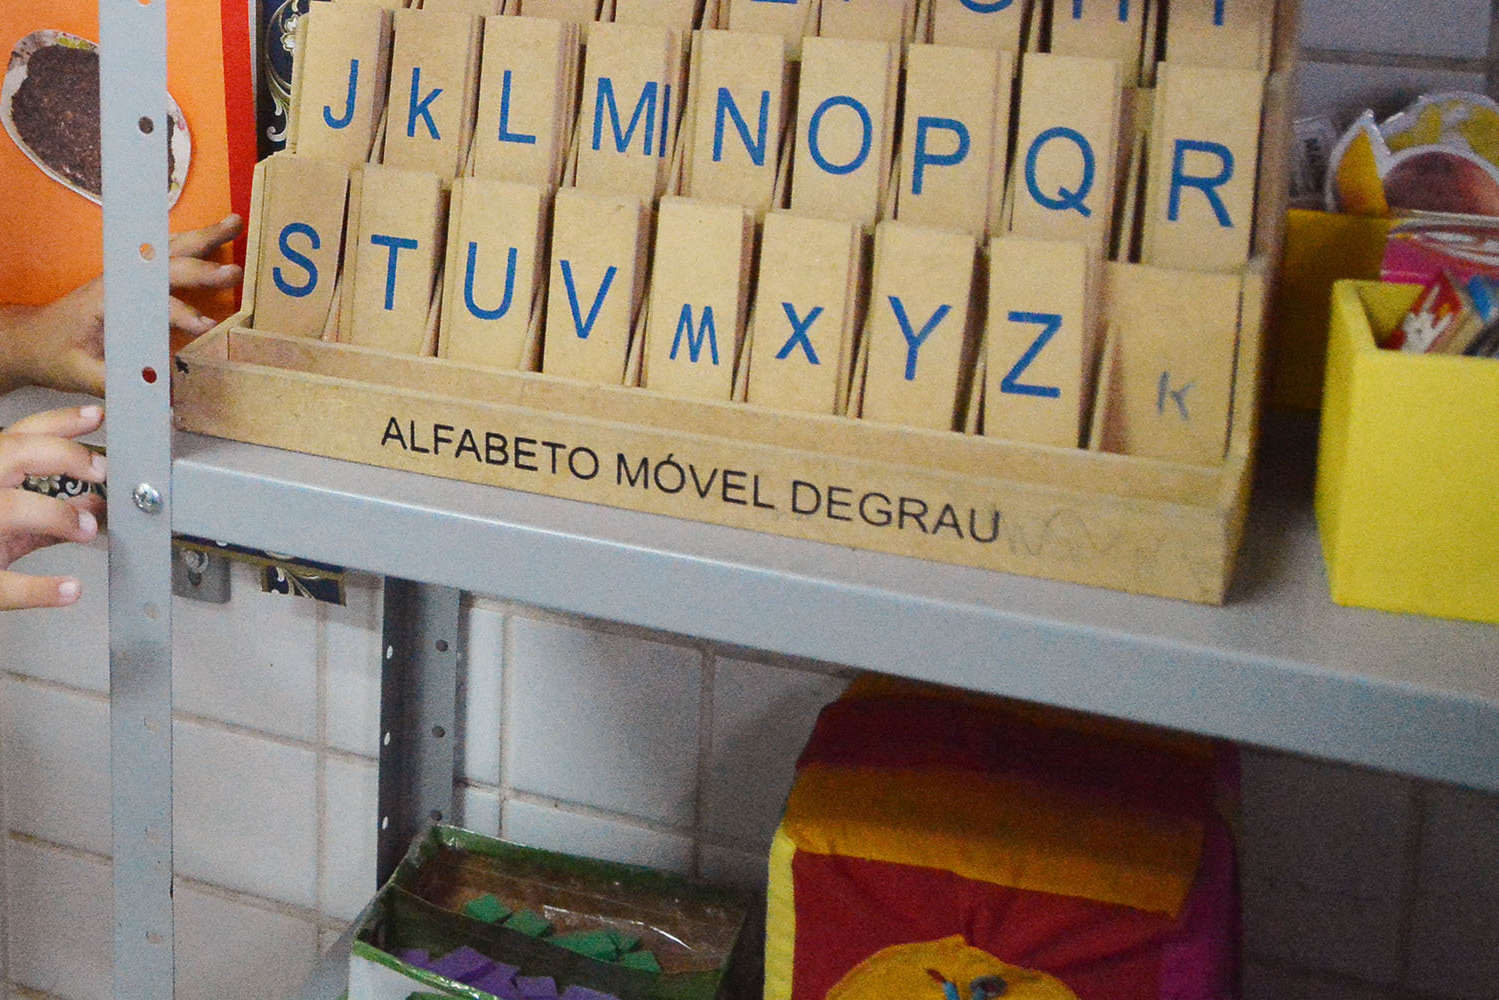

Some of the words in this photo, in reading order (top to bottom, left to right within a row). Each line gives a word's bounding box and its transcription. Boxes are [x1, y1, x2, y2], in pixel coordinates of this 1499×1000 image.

[324, 60, 358, 128] J
[499, 71, 535, 143] L
[714, 88, 769, 165] N
[809, 96, 872, 174] O
[913, 118, 969, 194] P
[1026, 128, 1094, 216] Q
[1169, 140, 1233, 226] R
[272, 222, 321, 298] S
[370, 234, 418, 310] T
[465, 243, 517, 319] U
[561, 261, 616, 338] V
[890, 297, 948, 379] Y
[1002, 312, 1062, 397] Z
[381, 416, 600, 481] ALFABETO
[615, 453, 775, 510] MÓVEL
[791, 479, 1001, 543] DEGRAU
